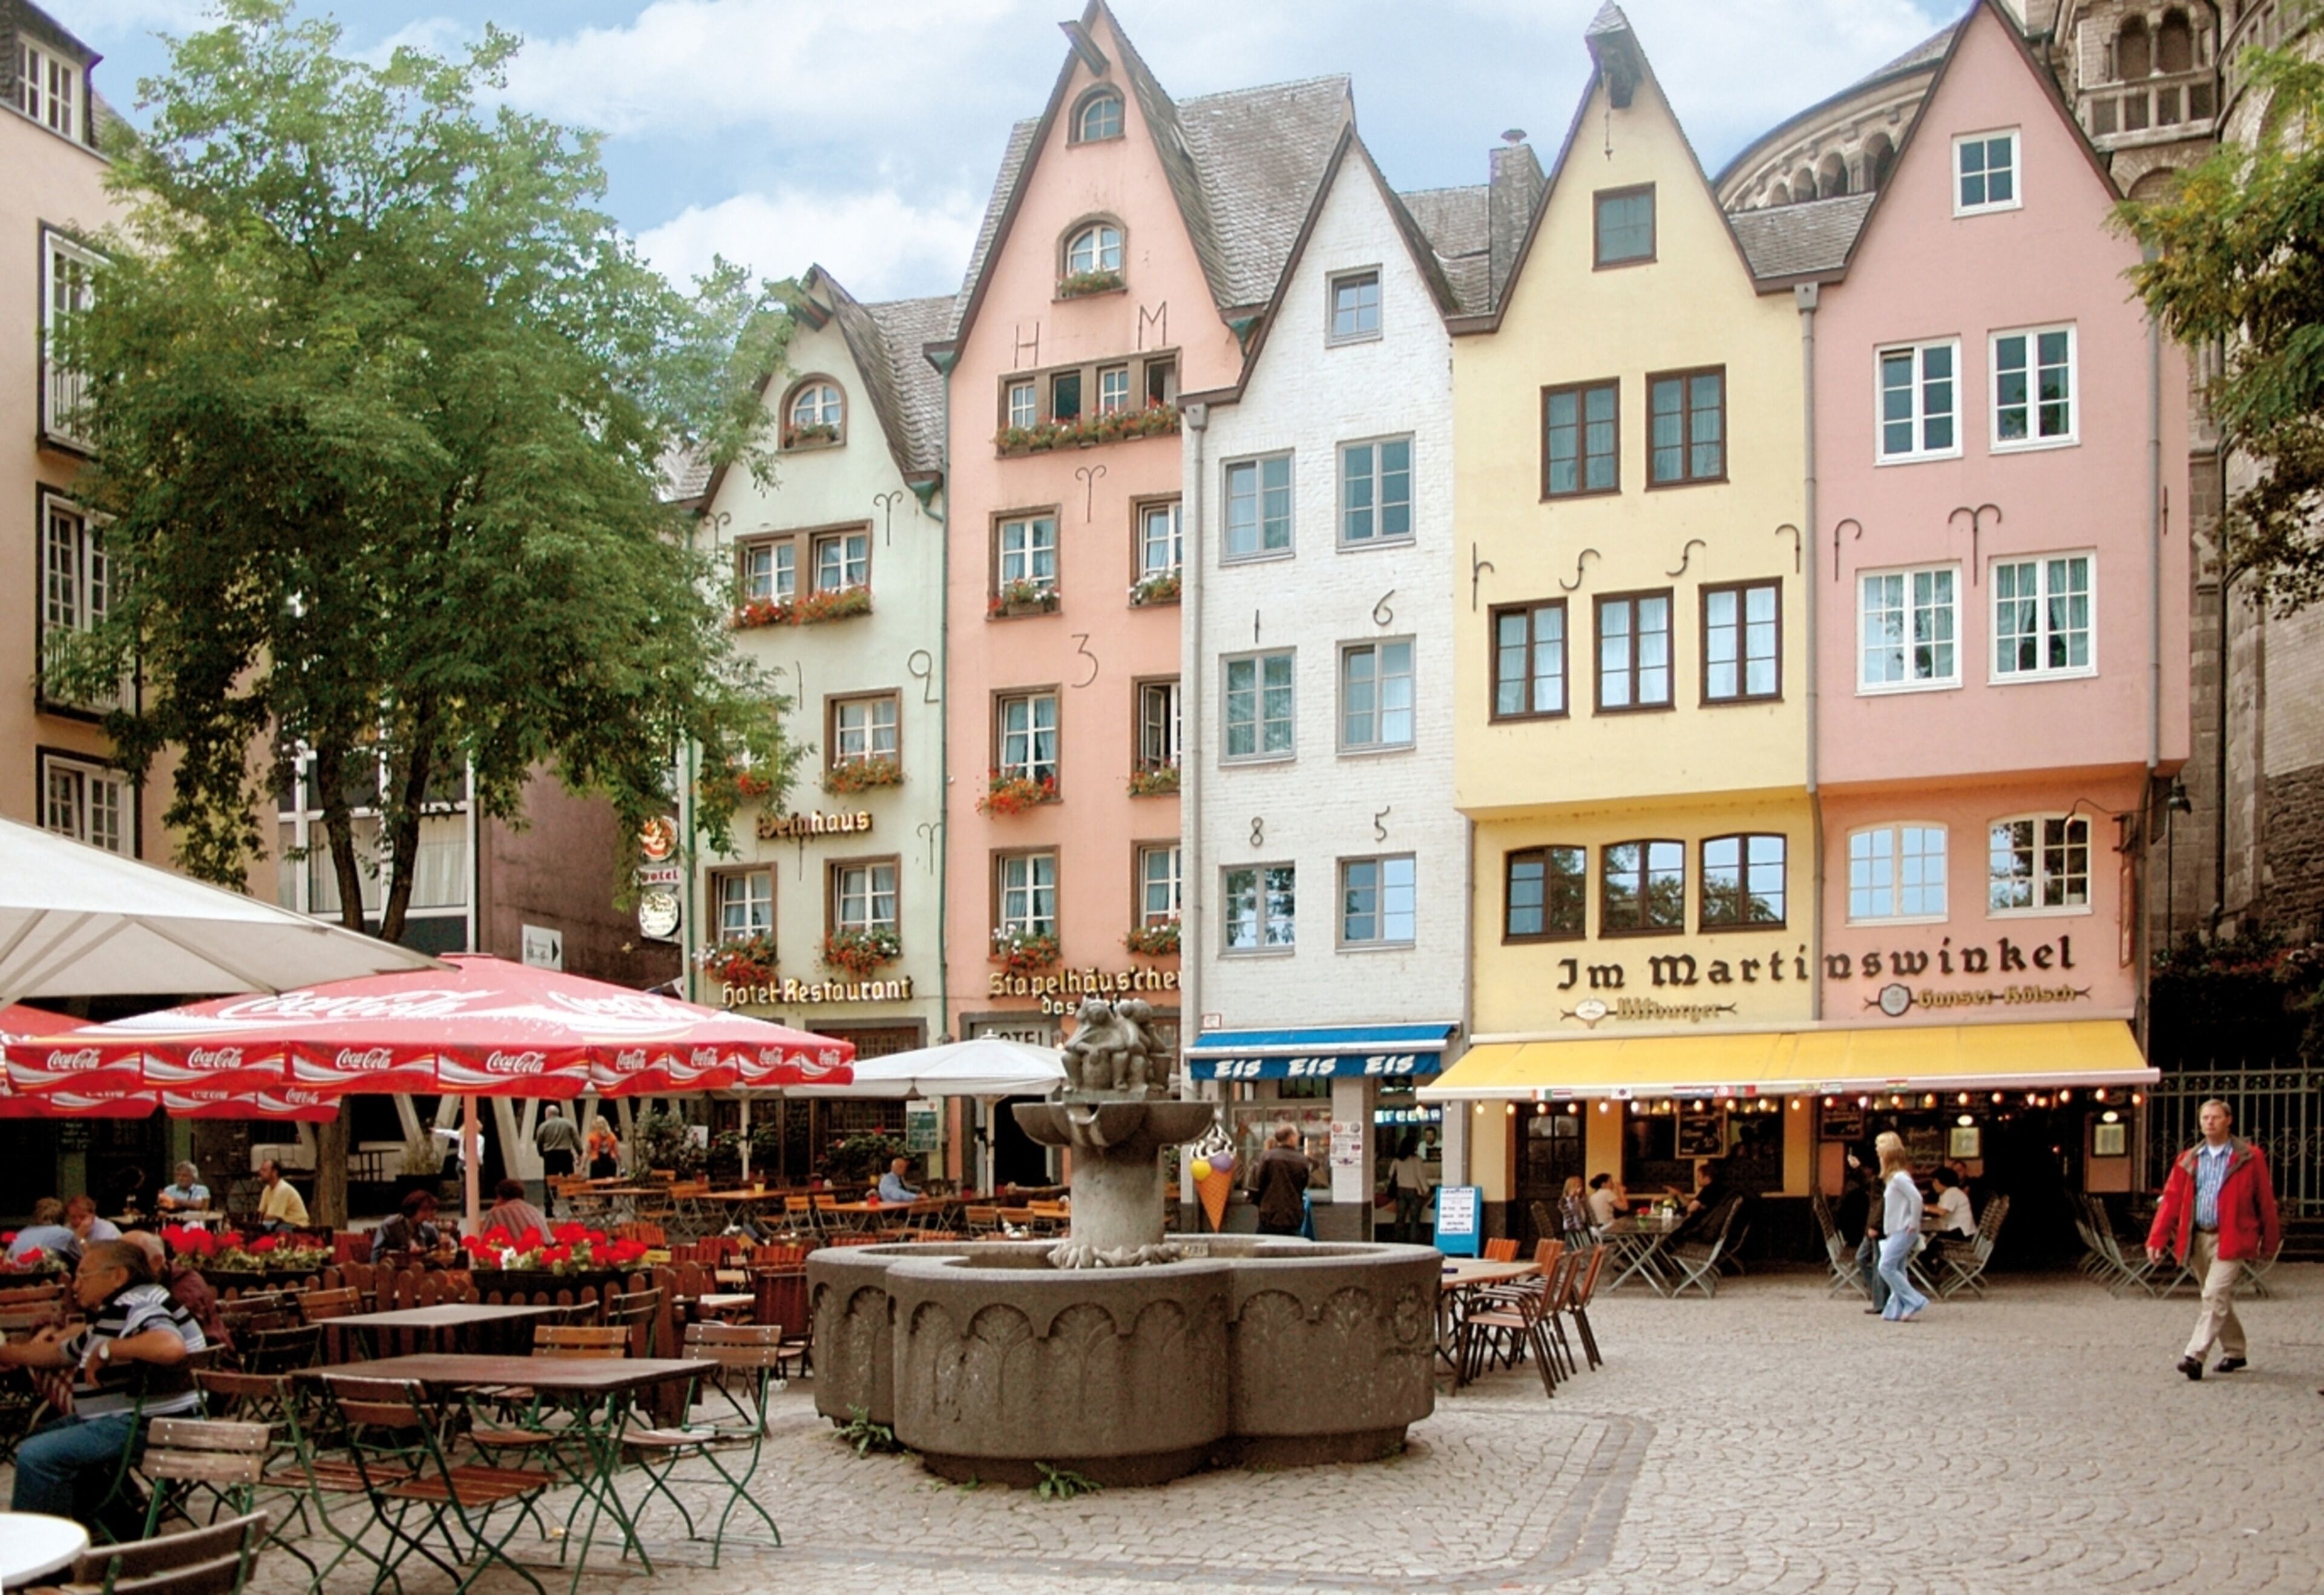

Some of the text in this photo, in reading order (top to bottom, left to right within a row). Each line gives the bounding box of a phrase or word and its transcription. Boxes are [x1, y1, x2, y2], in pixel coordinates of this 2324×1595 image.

[1215, 1054, 1415, 1077] EIS EIS EIS
